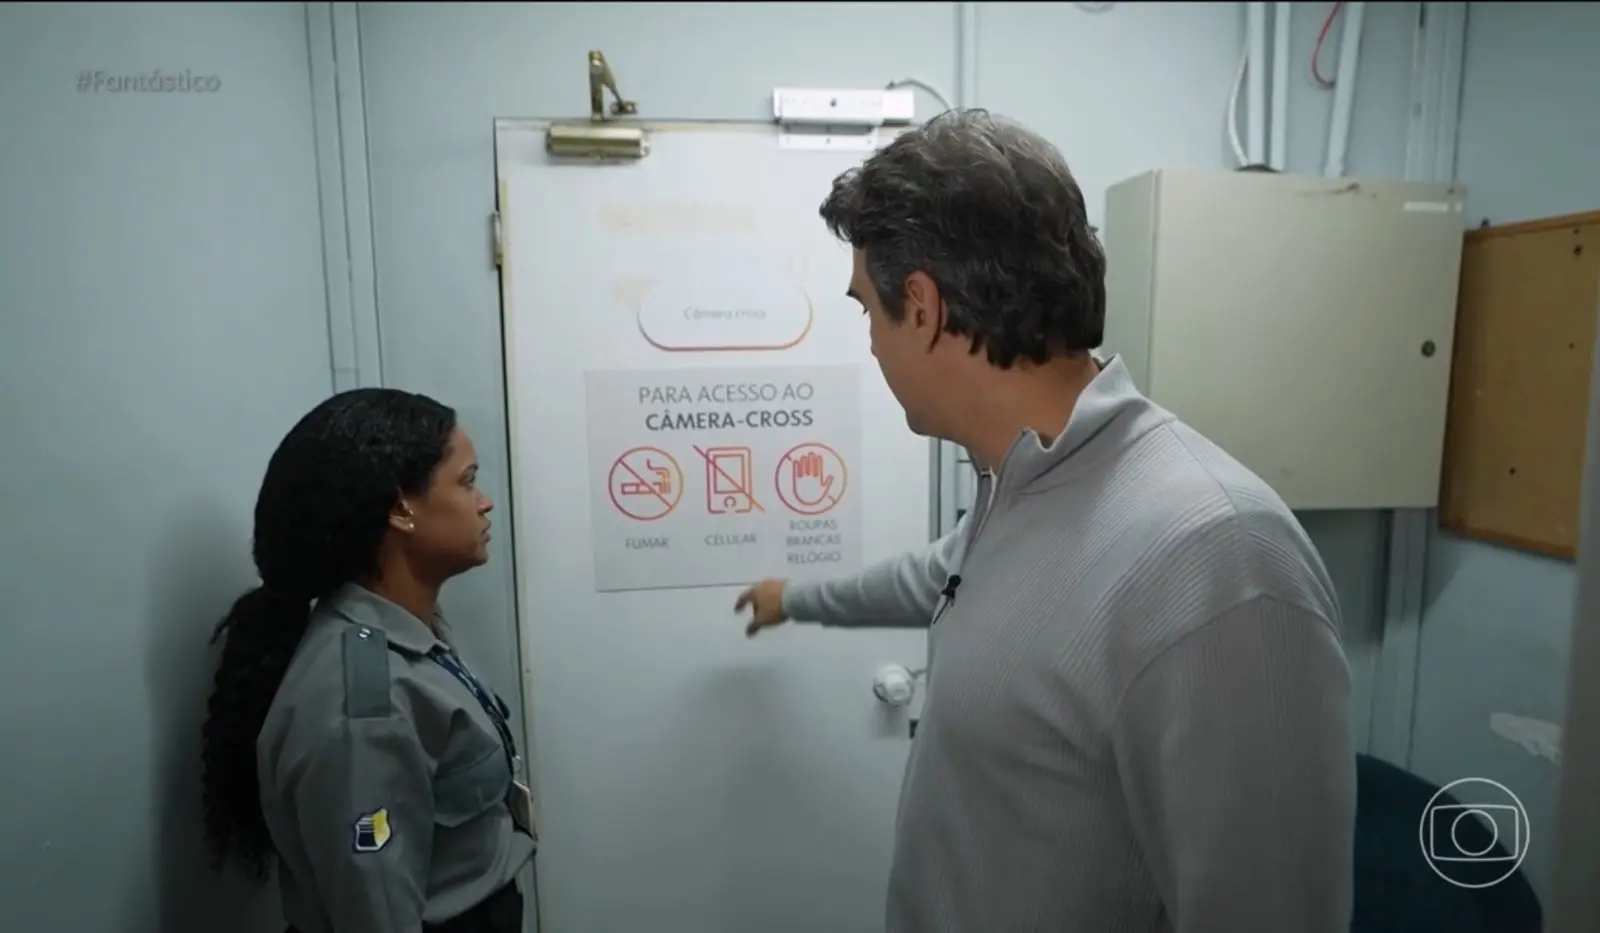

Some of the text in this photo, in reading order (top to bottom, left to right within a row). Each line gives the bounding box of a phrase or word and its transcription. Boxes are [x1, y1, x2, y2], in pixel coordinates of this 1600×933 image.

[639, 382, 814, 404] PARA ACESSO AO
[645, 409, 813, 431] CÂMERA-CROSS
[789, 519, 838, 531] ROUPAS
[625, 537, 670, 549] FUMAR
[704, 533, 757, 546] CELULAR
[786, 533, 841, 547] BRANCAS
[787, 549, 841, 565] RELÓGIO
